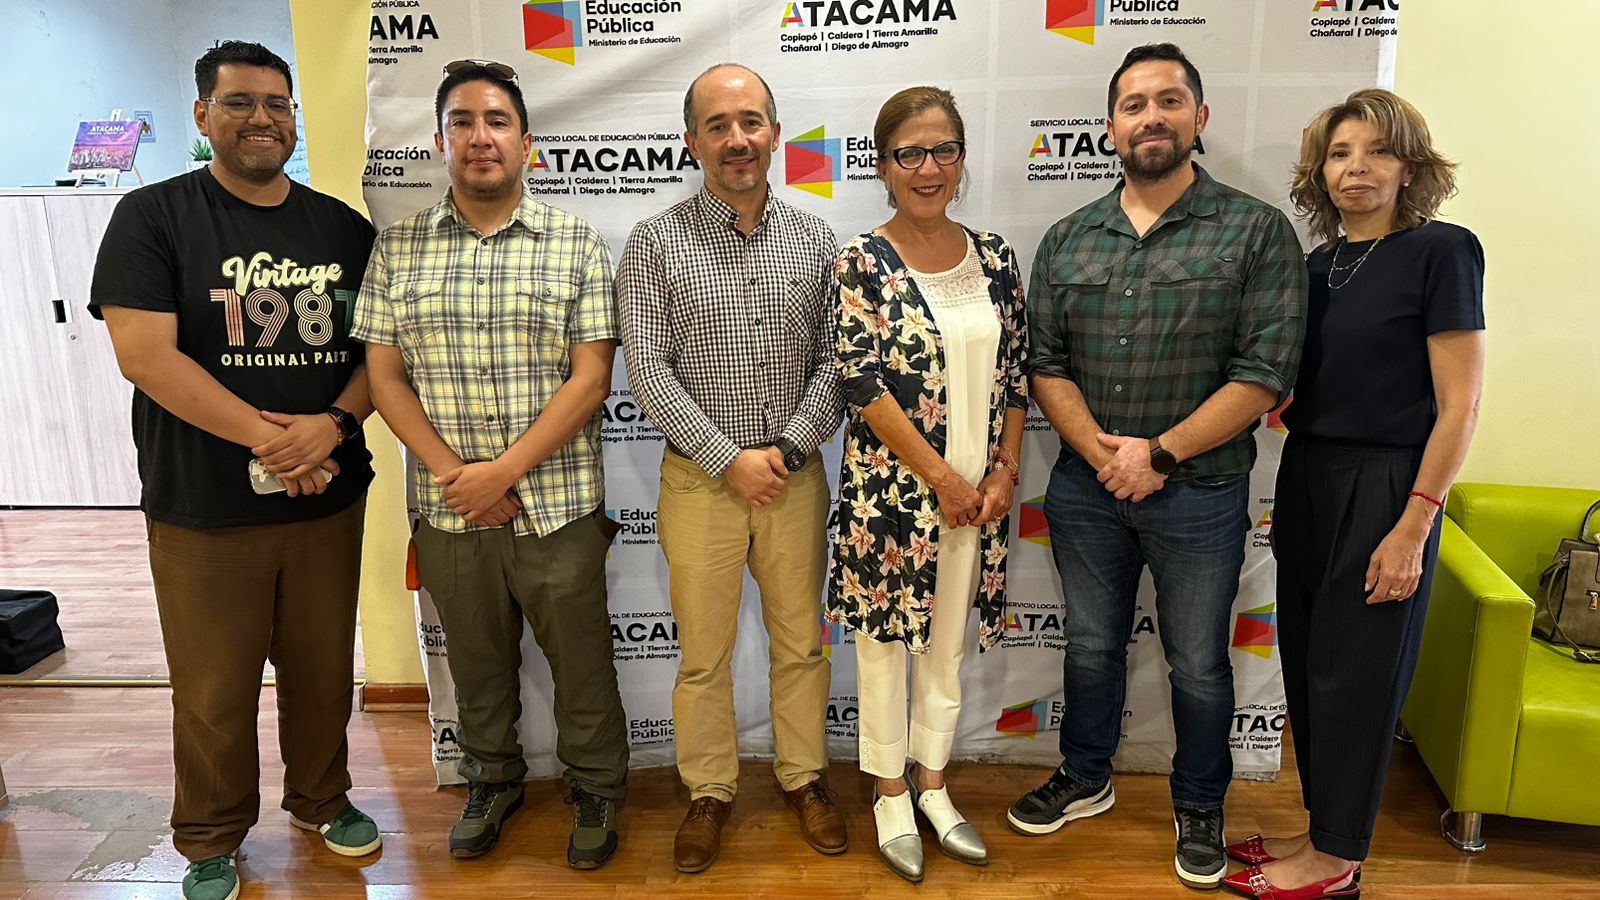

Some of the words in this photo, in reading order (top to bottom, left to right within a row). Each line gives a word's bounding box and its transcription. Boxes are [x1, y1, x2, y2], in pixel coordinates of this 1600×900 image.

[780, 0, 957, 28] ATACAMA
[586, 17, 654, 34] Pública
[1109, 18, 1149, 26] Ministerio
[1150, 17, 1161, 25] de
[1163, 17, 1206, 25] Educación
[1311, 17, 1351, 27] Copiapó
[1361, 16, 1396, 26] Caldera
[780, 32, 818, 43] Copiapó
[827, 31, 863, 41] Caldera
[873, 29, 899, 38] Tierra
[900, 27, 938, 36] Amarilla
[1310, 28, 1354, 37] Chañaral
[1364, 28, 1390, 38] Diego
[588, 38, 627, 47] Ministerio
[639, 35, 681, 45] Educación
[780, 43, 822, 53] Chañaral
[831, 42, 857, 52] Diego
[858, 41, 870, 49] de
[872, 40, 909, 50] Almagro
[389, 45, 423, 54] Amarilla
[1030, 119, 1066, 127] SERVICIO
[1067, 118, 1094, 126] LOCAL
[1095, 118, 1105, 126] DE
[531, 134, 560, 143] ERVICIO
[562, 134, 587, 142] LOCAL
[589, 134, 599, 142] DE
[600, 133, 646, 142] EDUCACIÓN
[648, 132, 681, 141] PÚBLICA
[367, 146, 431, 160] ucación
[526, 147, 700, 173] ATACAMA
[1028, 162, 1064, 172] Copiapó
[1074, 161, 1109, 170] Caldera
[528, 176, 565, 186] Copiapó
[575, 176, 609, 185] Caldera
[619, 176, 645, 184] Tierra
[647, 175, 683, 184] Amarilla
[1028, 172, 1067, 181] Chañaral
[1077, 172, 1102, 181] Diego
[1104, 171, 1115, 179] de
[389, 180, 432, 188] Educación
[530, 186, 570, 195] Chañaral
[579, 186, 604, 195] Diego
[605, 186, 617, 194] de
[618, 186, 656, 195] Almagro
[221, 251, 343, 297] Vintage
[221, 353, 308, 367] ORIGINAL
[601, 426, 627, 434] aldera
[600, 435, 622, 443] Diego
[621, 521, 656, 535] Públ
[632, 610, 672, 618] EDUCACIÓN
[1001, 641, 1035, 649] Chañaral
